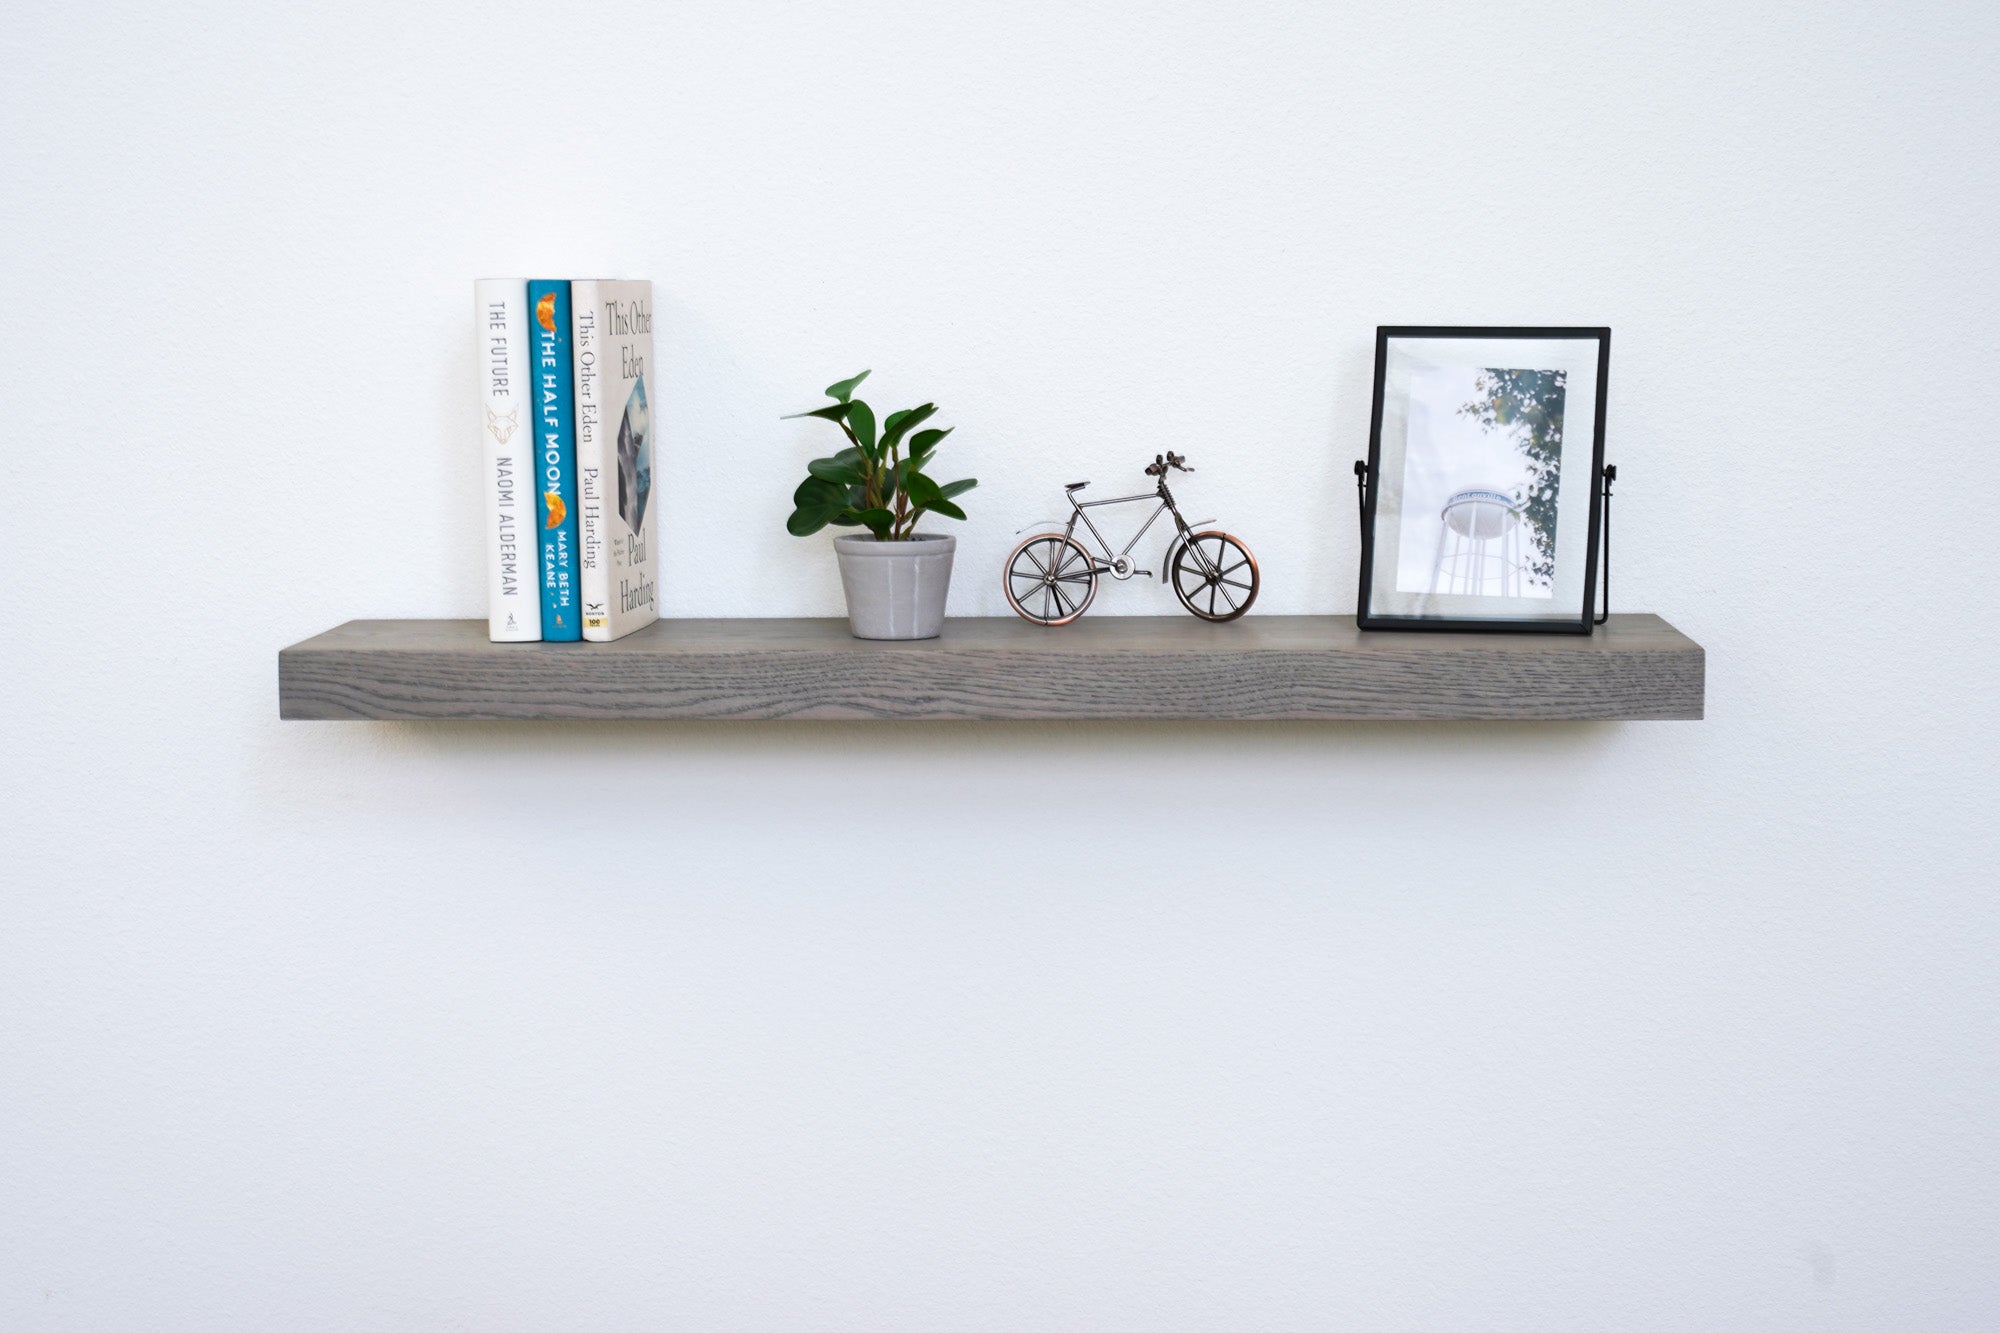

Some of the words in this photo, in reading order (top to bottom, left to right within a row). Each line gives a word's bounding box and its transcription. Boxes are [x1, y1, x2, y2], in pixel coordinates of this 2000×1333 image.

[489, 301, 506, 330] THE
[580, 311, 596, 347] This
[606, 301, 629, 336] This
[630, 300, 652, 336] Other
[491, 337, 510, 397] FUTURE
[541, 331, 557, 368] THE
[622, 344, 644, 379] Eden
[580, 351, 597, 399] Other
[542, 373, 560, 428] HALF
[582, 404, 598, 443] Eden
[496, 457, 515, 507] NAOMI
[545, 433, 562, 496] MOON
[584, 468, 600, 500] Paul
[499, 514, 519, 596] ALDERMAN
[557, 530, 569, 568] MARY
[583, 506, 602, 569] Harding
[628, 527, 647, 567] Paul
[545, 544, 557, 589] KEANE
[558, 572, 570, 607] BETH
[620, 571, 655, 613] Harding
